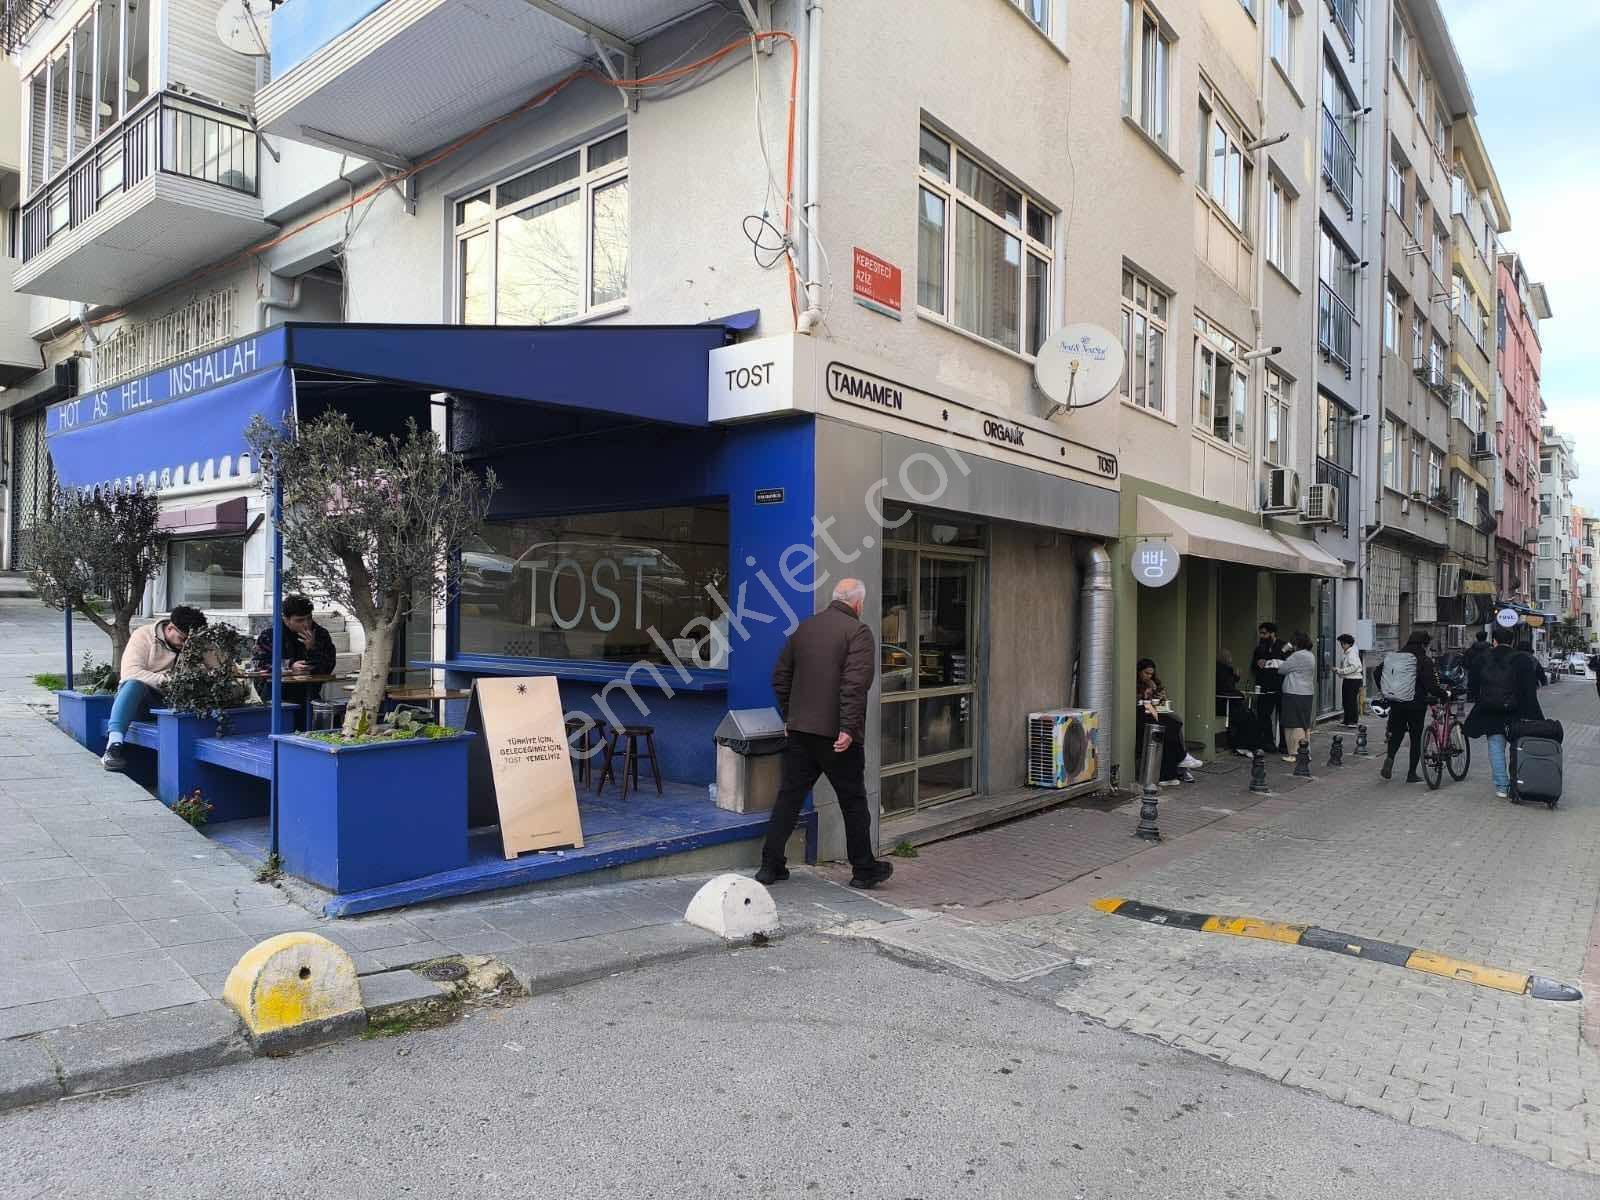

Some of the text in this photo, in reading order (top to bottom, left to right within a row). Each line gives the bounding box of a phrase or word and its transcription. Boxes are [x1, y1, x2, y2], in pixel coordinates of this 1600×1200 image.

[59, 338, 257, 430] HOT AS HELL INSHALLAH
[725, 362, 775, 391] TOST
[831, 369, 1115, 475] TAMAMEN ORGANİK TOST
[519, 557, 658, 632] TOST
[1142, 549, 1168, 578] 빵
